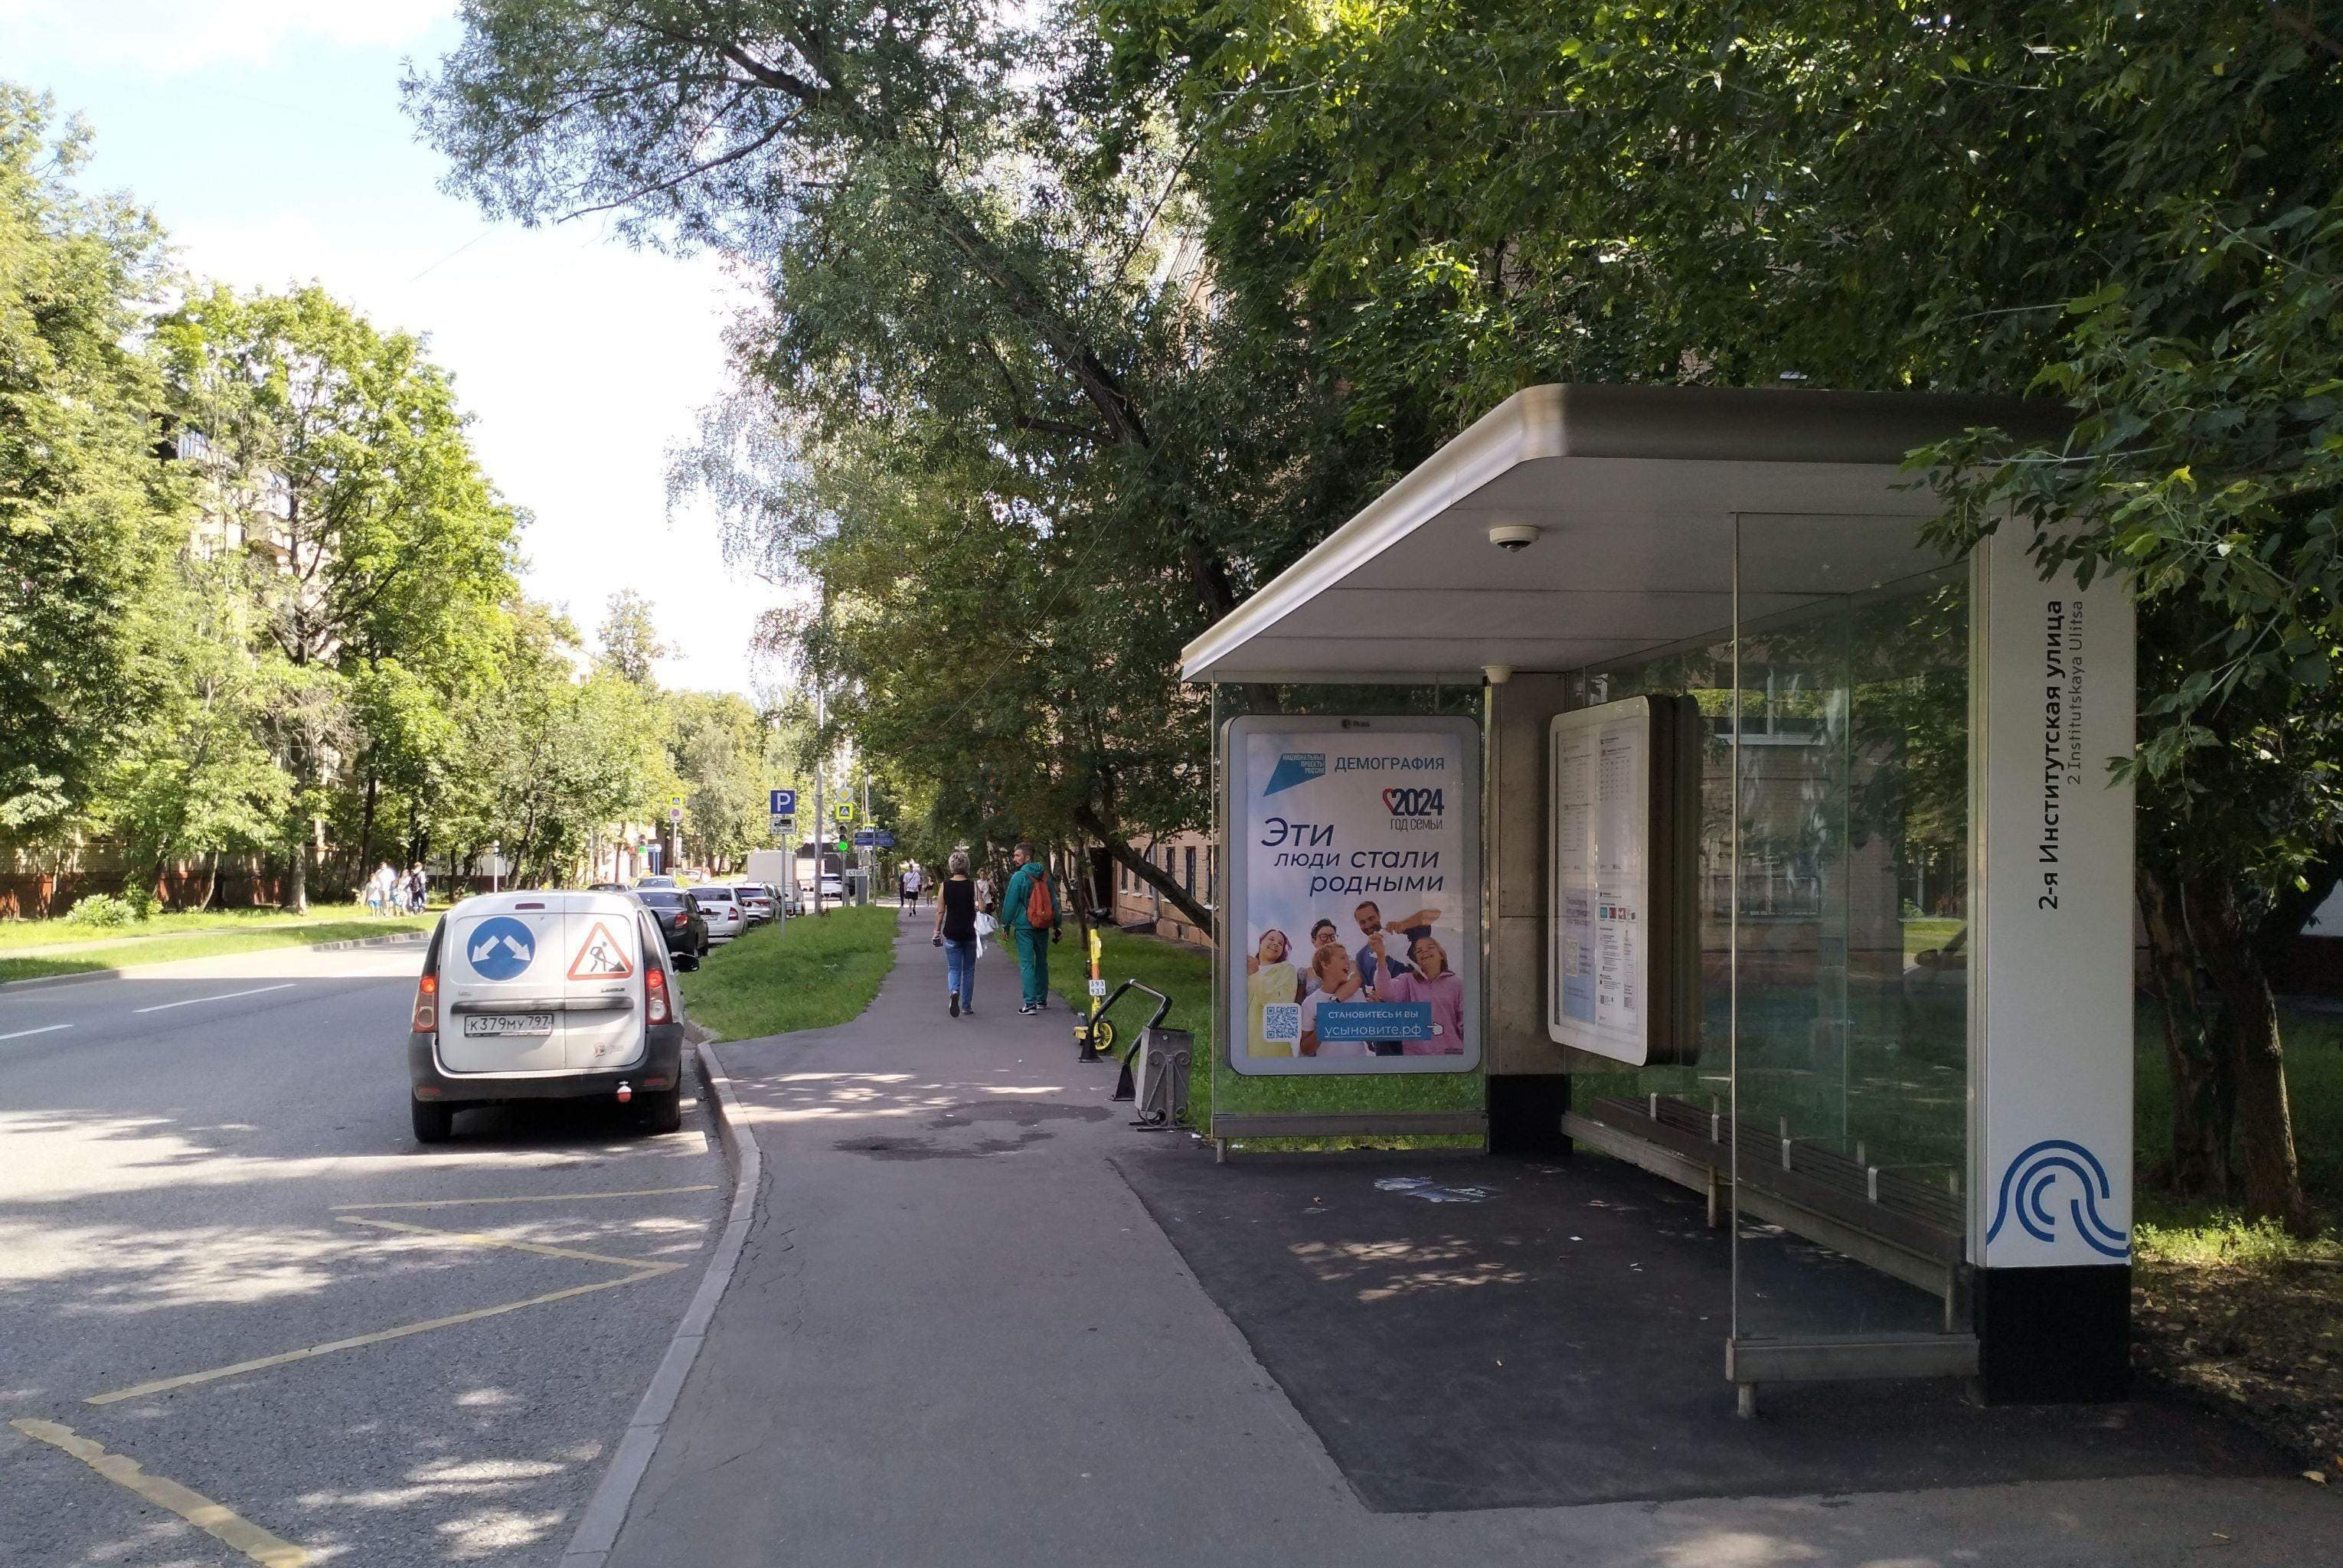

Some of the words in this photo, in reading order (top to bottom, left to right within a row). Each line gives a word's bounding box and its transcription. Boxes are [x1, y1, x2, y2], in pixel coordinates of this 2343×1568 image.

[2047, 600, 2065, 678] улица
[2069, 601, 2083, 651] Ulitsa
[2068, 656, 2086, 769] Institutskaya
[1335, 757, 1444, 772] ДЕМОГРАФИЯ
[2039, 686, 2064, 862] Институтская
[2067, 775, 2081, 786] 2
[1390, 788, 1444, 816] 2024
[1261, 817, 1334, 847] Эти
[1274, 852, 1339, 870] люди
[1351, 851, 1439, 868] стали
[1309, 874, 1443, 897] родными
[2039, 872, 2059, 910] 2-я
[1328, 1010, 1394, 1019] СТАНОВИТЕСЬ
[1395, 1010, 1403, 1019] И
[1404, 1010, 1419, 1019] ВЫ
[1325, 1023, 1422, 1037] усыновите.рф
